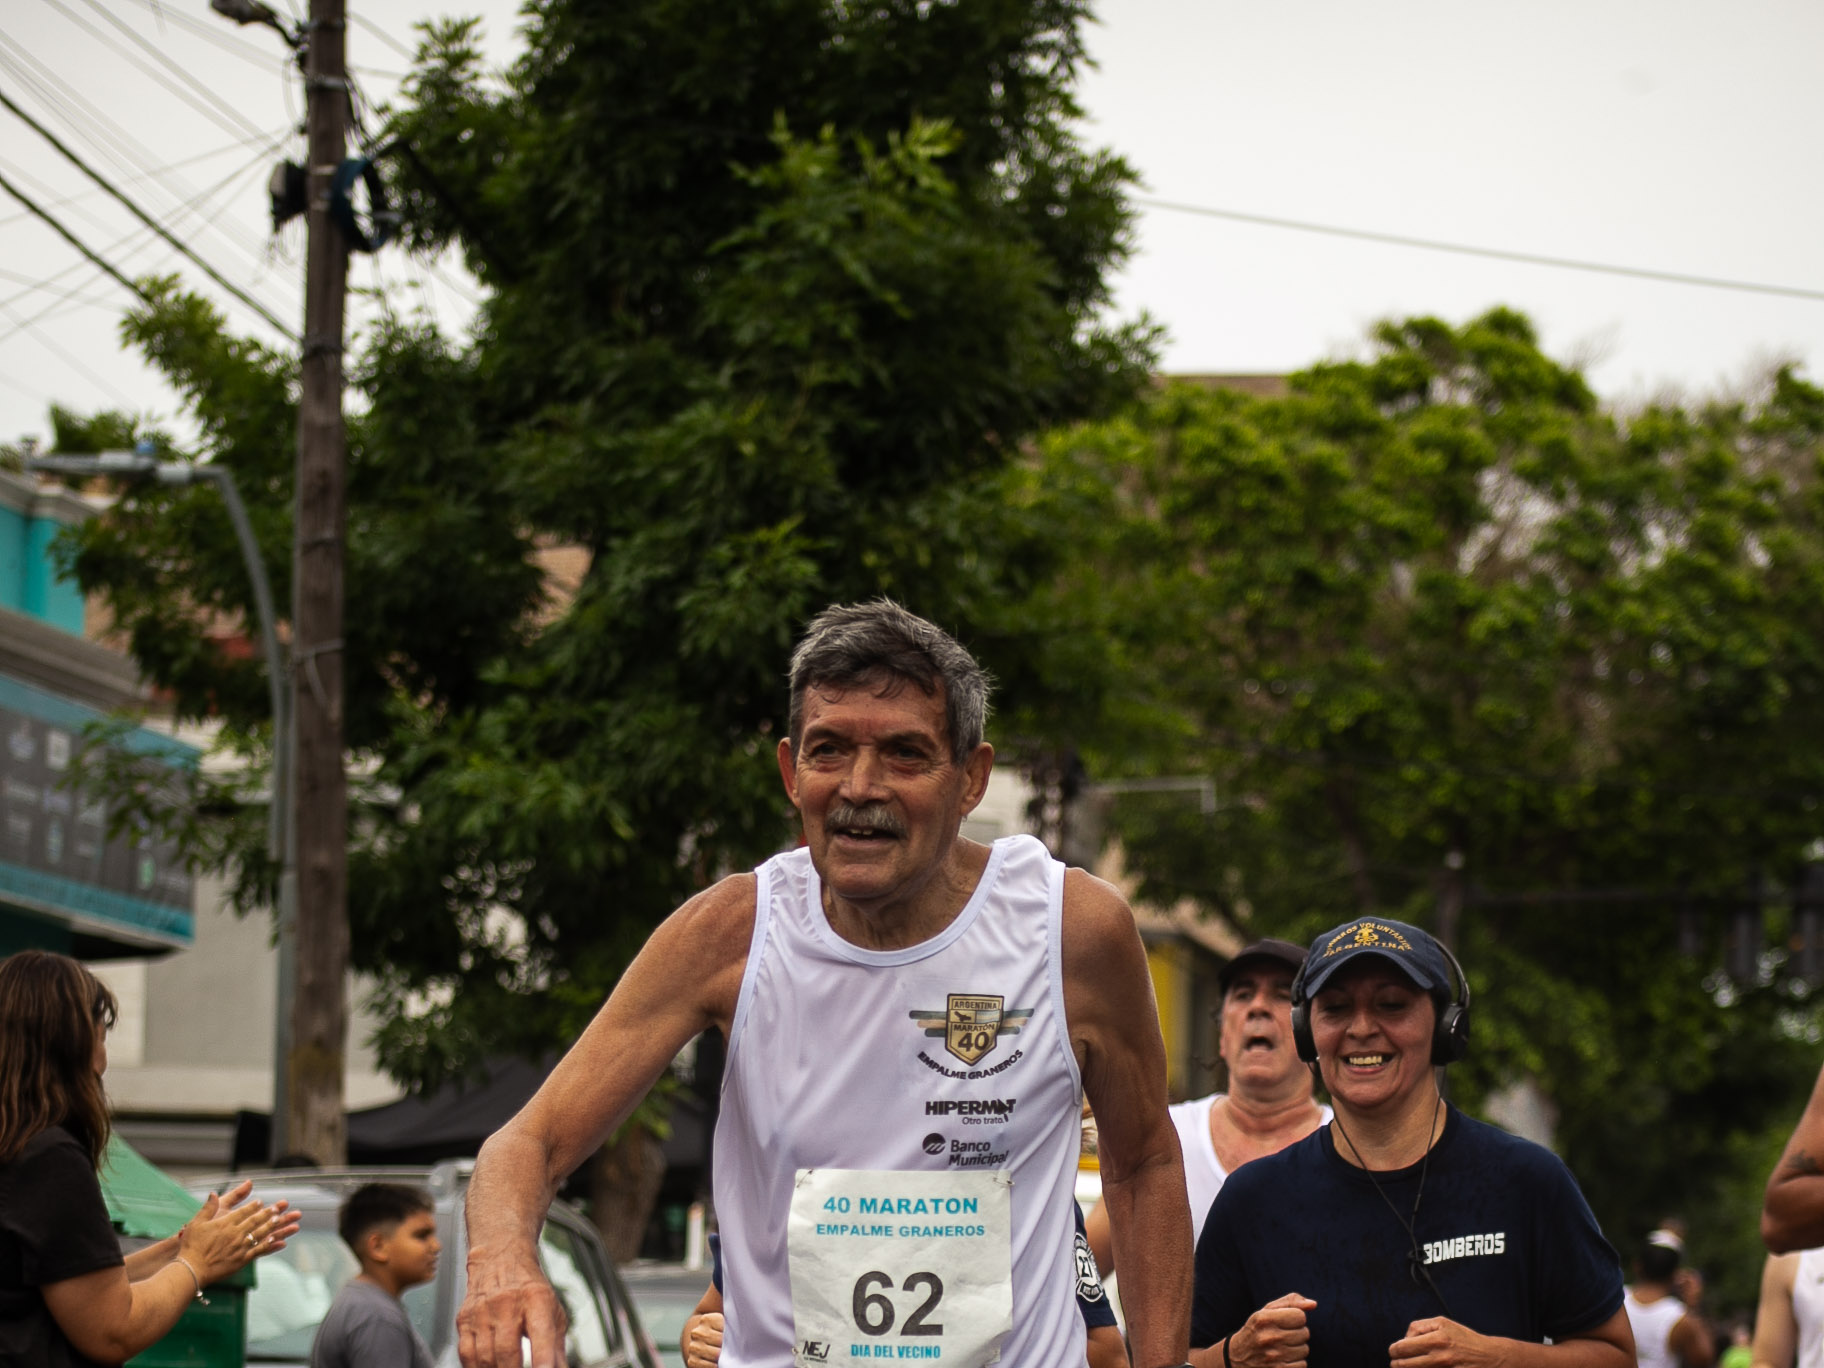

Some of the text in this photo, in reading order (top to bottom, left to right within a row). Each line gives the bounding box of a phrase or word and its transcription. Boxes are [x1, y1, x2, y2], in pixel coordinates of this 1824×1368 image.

[953, 1000, 998, 1010] ARGENTINA
[957, 1031, 990, 1052] 40
[917, 1049, 1024, 1080] EMPALME GRANEROS
[962, 1116, 982, 1125] Otro
[951, 1139, 991, 1153] Banco
[948, 1150, 1010, 1167] Municipal
[823, 1196, 979, 1215] 40 MARATON
[816, 1223, 985, 1238] EMPALME GRANEROS
[1423, 1232, 1505, 1264] BOMBEROS
[852, 1270, 944, 1337] 62
[850, 1344, 941, 1359] DIA DEL VECINO
